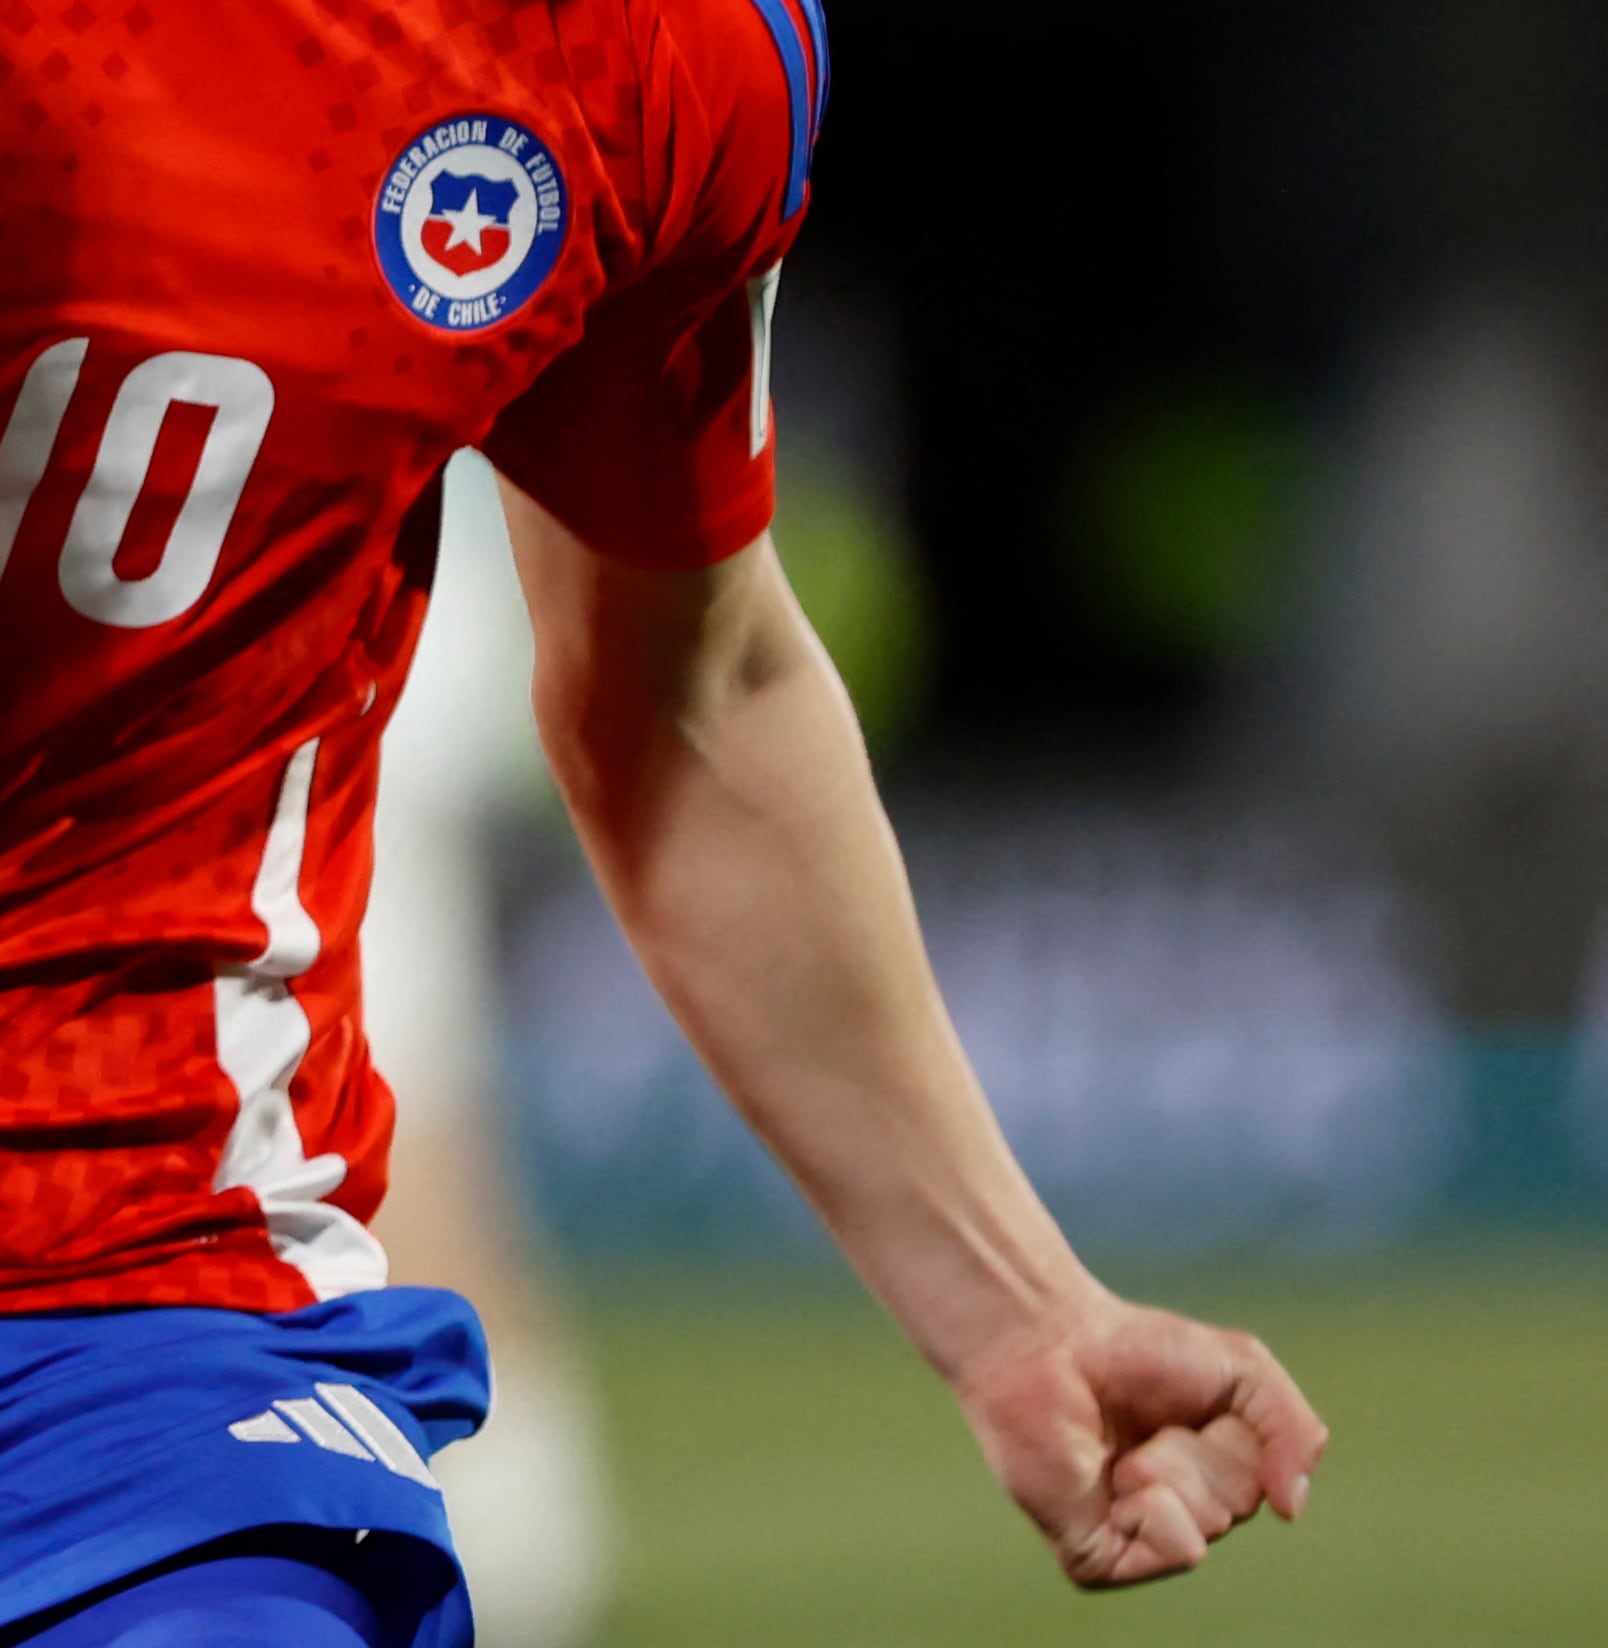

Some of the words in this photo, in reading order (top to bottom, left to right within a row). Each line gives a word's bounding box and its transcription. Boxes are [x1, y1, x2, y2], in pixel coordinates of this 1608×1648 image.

[382, 120, 487, 213] FEDERACION
[499, 127, 528, 157] DE
[526, 153, 560, 234] FUTBOL
[412, 285, 440, 319] DE
[448, 293, 501, 326] CHILE
